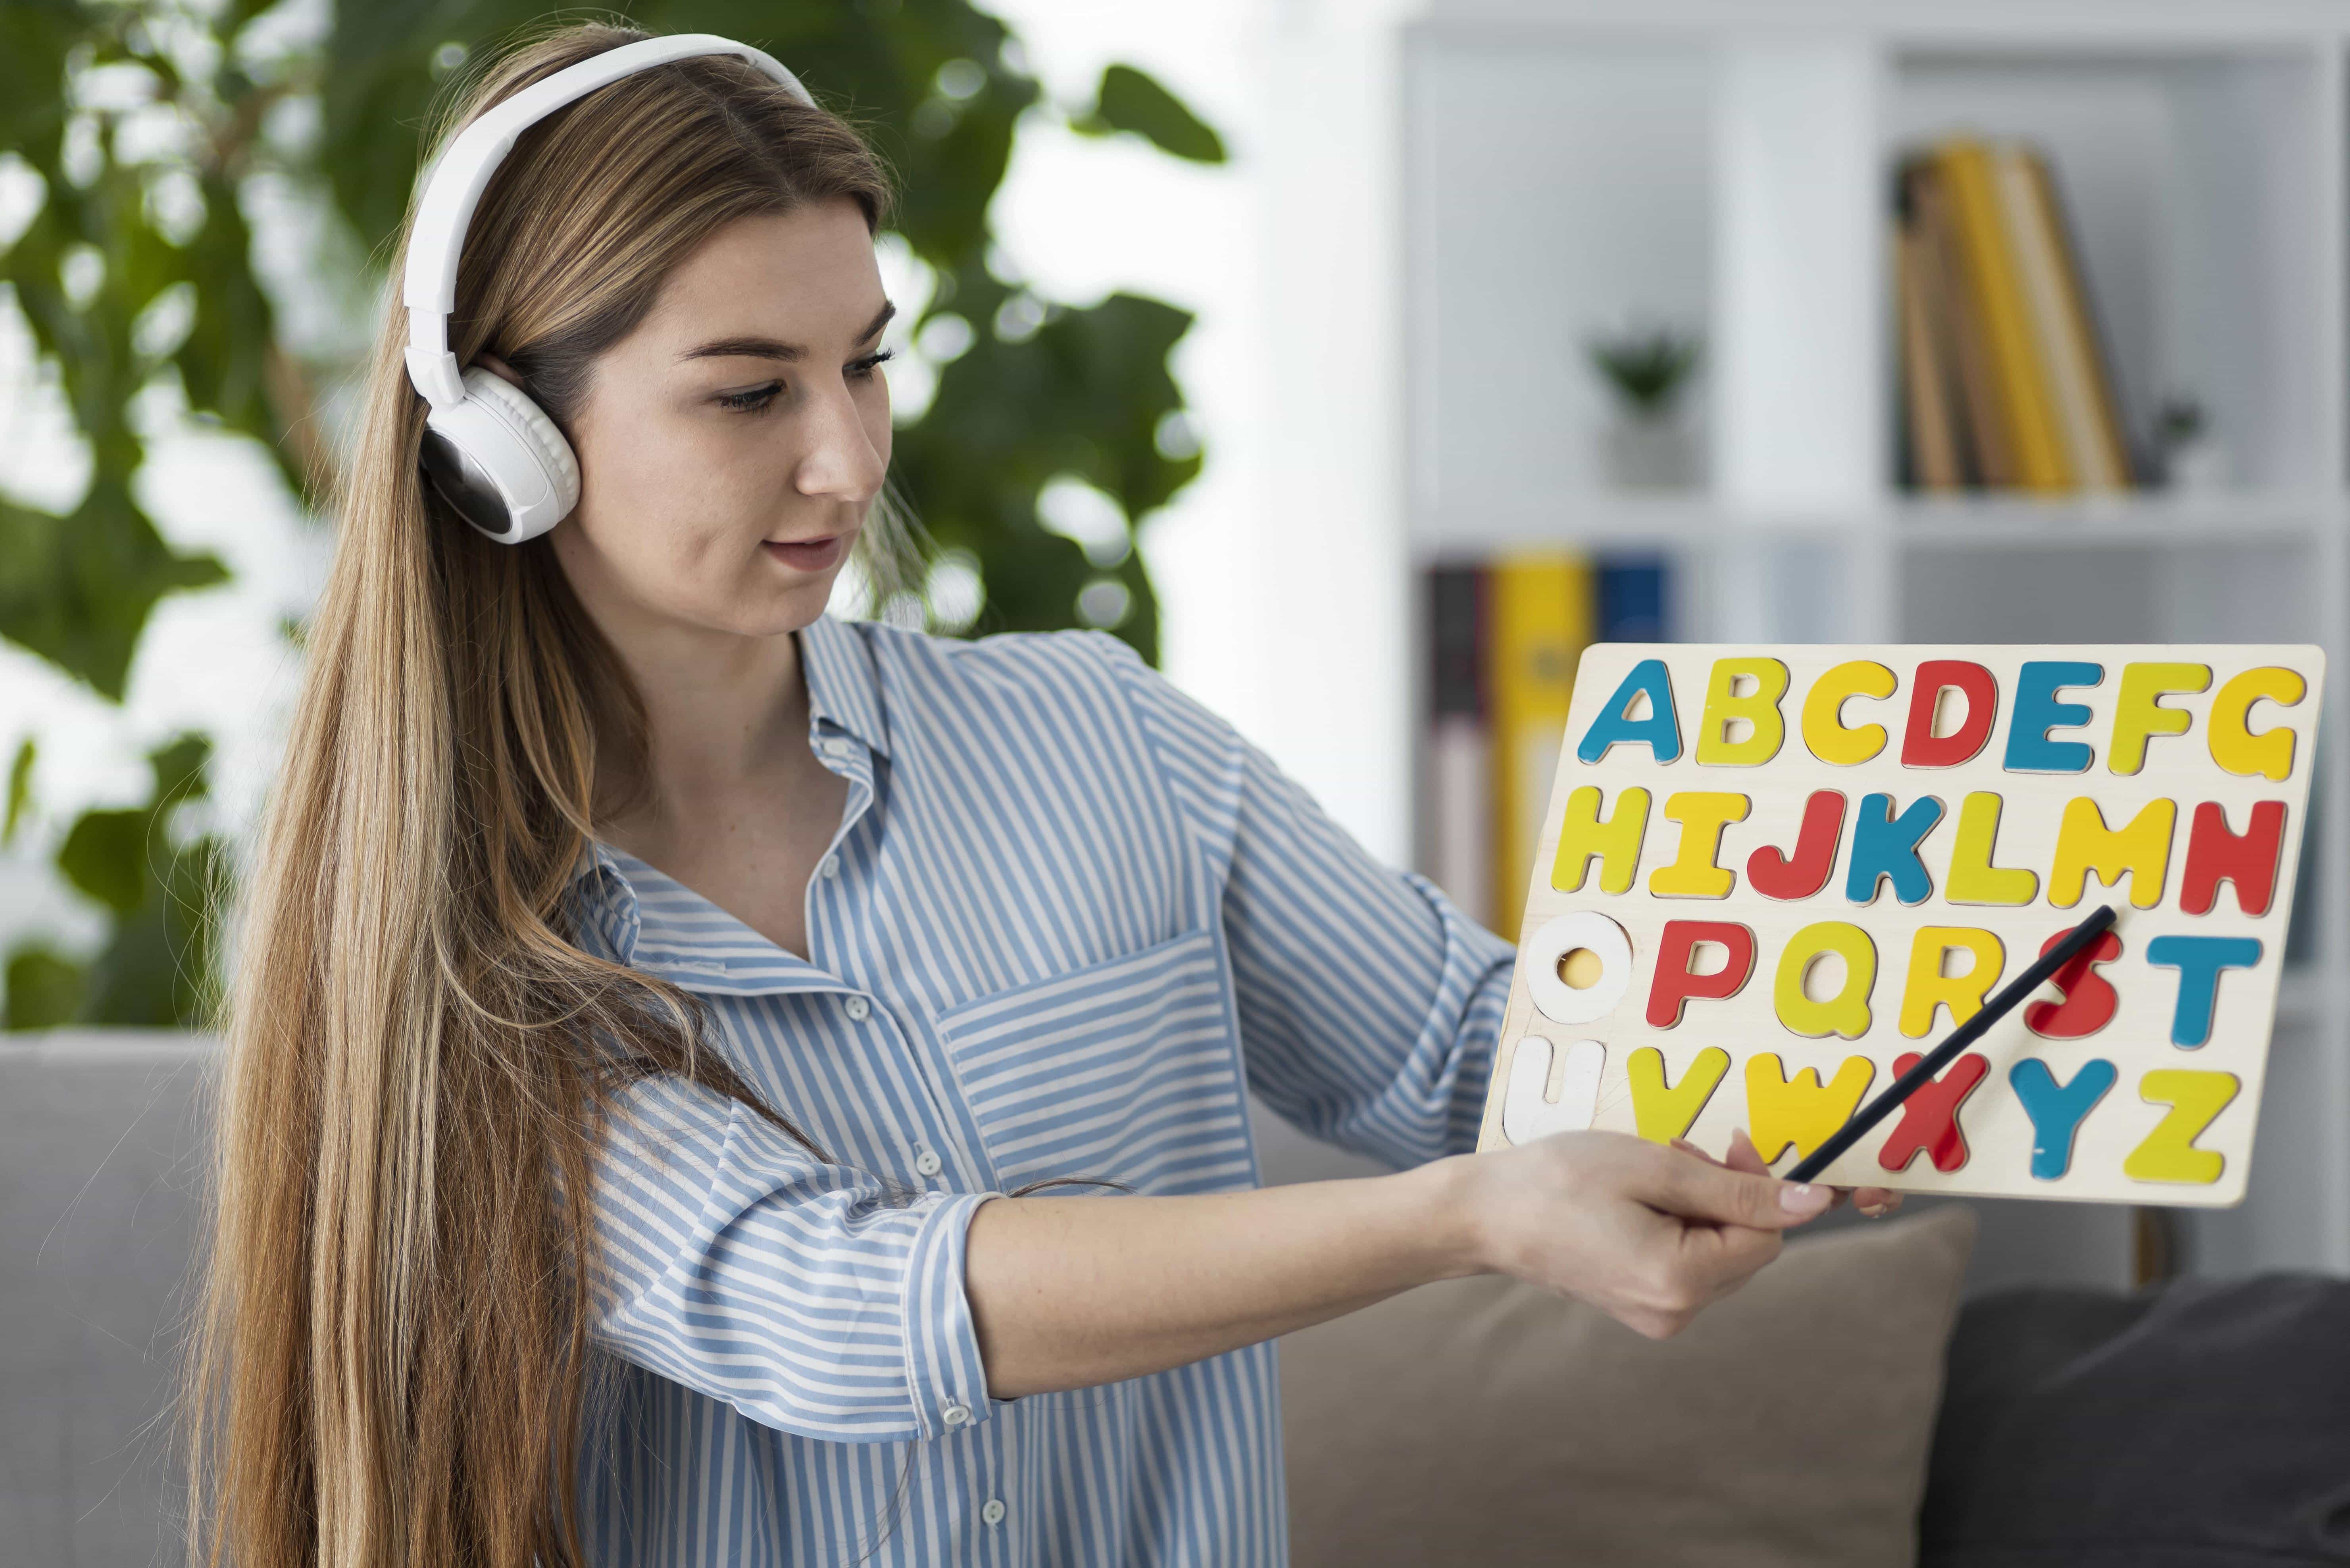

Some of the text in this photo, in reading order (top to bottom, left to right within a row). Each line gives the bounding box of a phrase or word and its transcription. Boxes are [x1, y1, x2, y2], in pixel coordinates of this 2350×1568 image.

[1577, 657, 2306, 782] A B C D E F G
[1550, 786, 2285, 916] H I J K L M N
[1526, 911, 2260, 1047] O P Q R S T
[1503, 1035, 2238, 1185] U V W X Y Z
